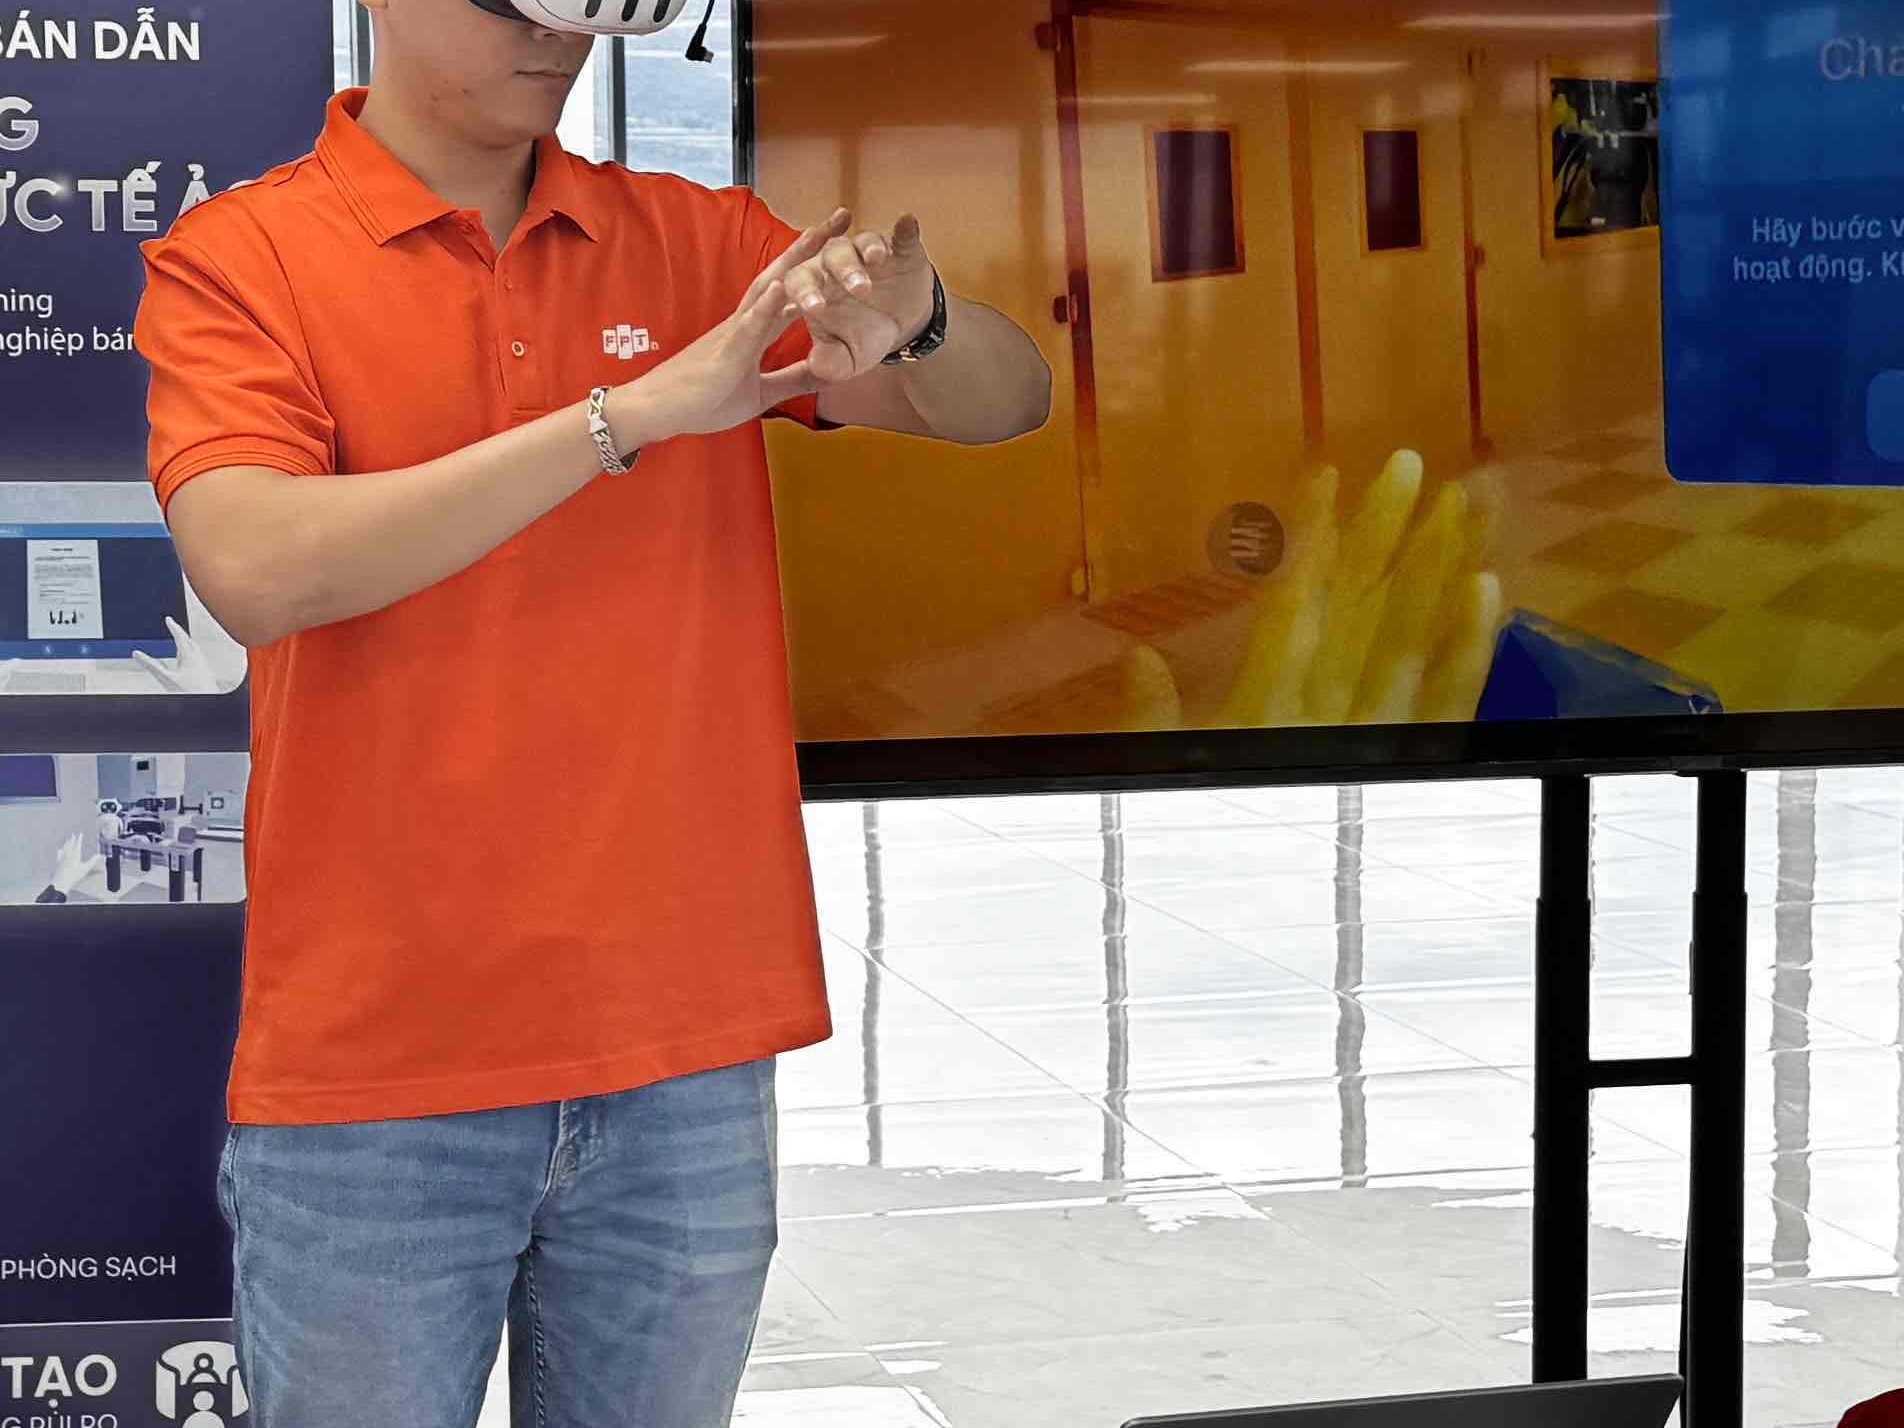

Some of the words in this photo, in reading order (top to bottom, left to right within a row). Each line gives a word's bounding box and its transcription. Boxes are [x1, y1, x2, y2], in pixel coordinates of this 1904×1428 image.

[93, 4, 201, 62] DẪN
[78, 157, 159, 233] TẾ
[1752, 217, 1801, 247] Hãy
[1812, 216, 1882, 241] bước
[1733, 256, 1793, 284] hoạt
[1799, 254, 1872, 283] động.
[1, 1250, 98, 1282] PHÒNG
[103, 1253, 177, 1284] SẠCH
[1, 1352, 118, 1410] TẠO
